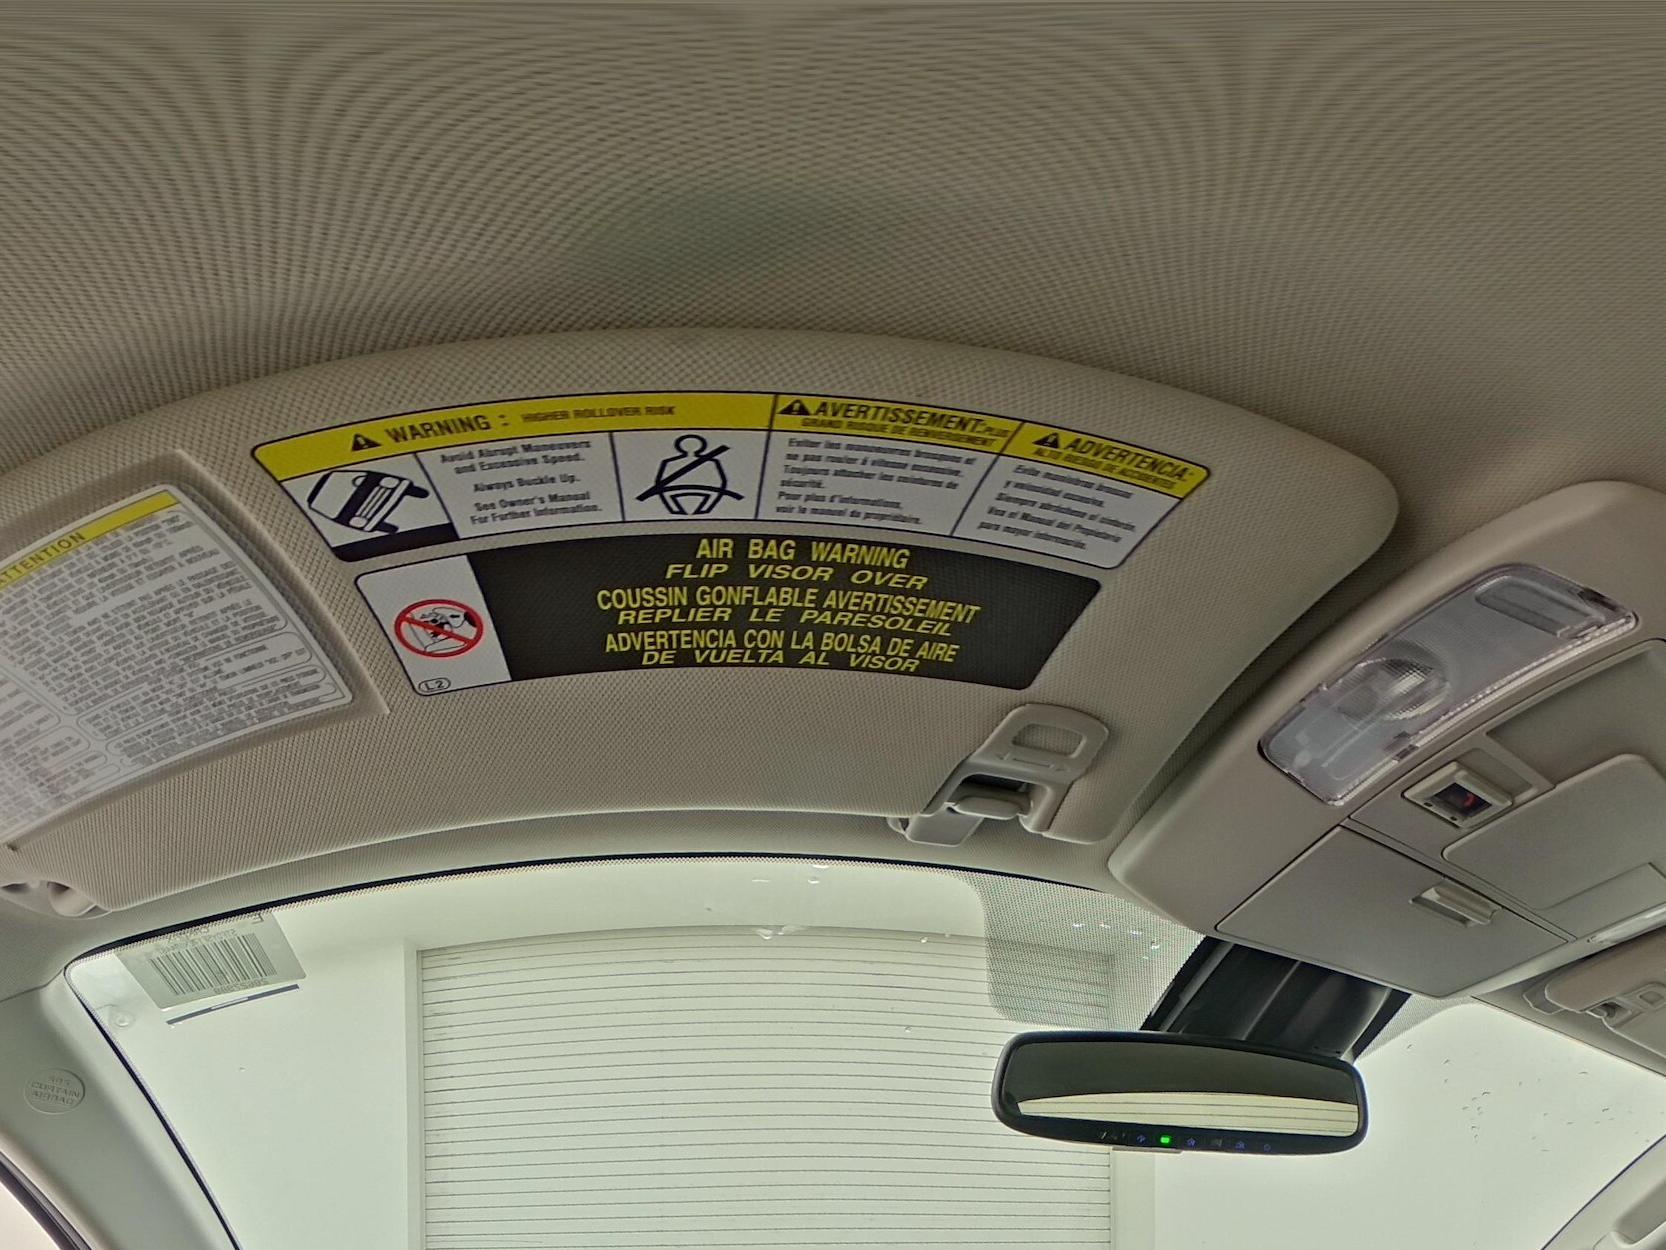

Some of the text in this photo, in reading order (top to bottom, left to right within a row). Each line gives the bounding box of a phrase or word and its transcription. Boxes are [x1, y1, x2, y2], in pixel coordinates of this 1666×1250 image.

[521, 406, 676, 424] HIGHER ROLLOVER RISK
[385, 415, 491, 444] WARNING
[441, 441, 591, 464] Avoid Abrupt Maneuvers
[454, 453, 585, 474] and Excessive Speed.
[474, 474, 581, 492] Always Buckle Up.
[475, 492, 590, 512] See Owner's Manual
[471, 503, 602, 525] For Further Information.
[696, 538, 911, 569] AIR BAG WARNING
[665, 564, 929, 590] FLIP VISOR OVER
[597, 586, 981, 624] COUSSIN GONFLABLE AVERTISSEMENT
[618, 608, 952, 636] REPLIER LE PARESOLEIL
[605, 628, 960, 662] ADVERTENCIA CON LA BOLSA DE AIRE
[641, 650, 920, 672] DE VUELTA AL VISOR
